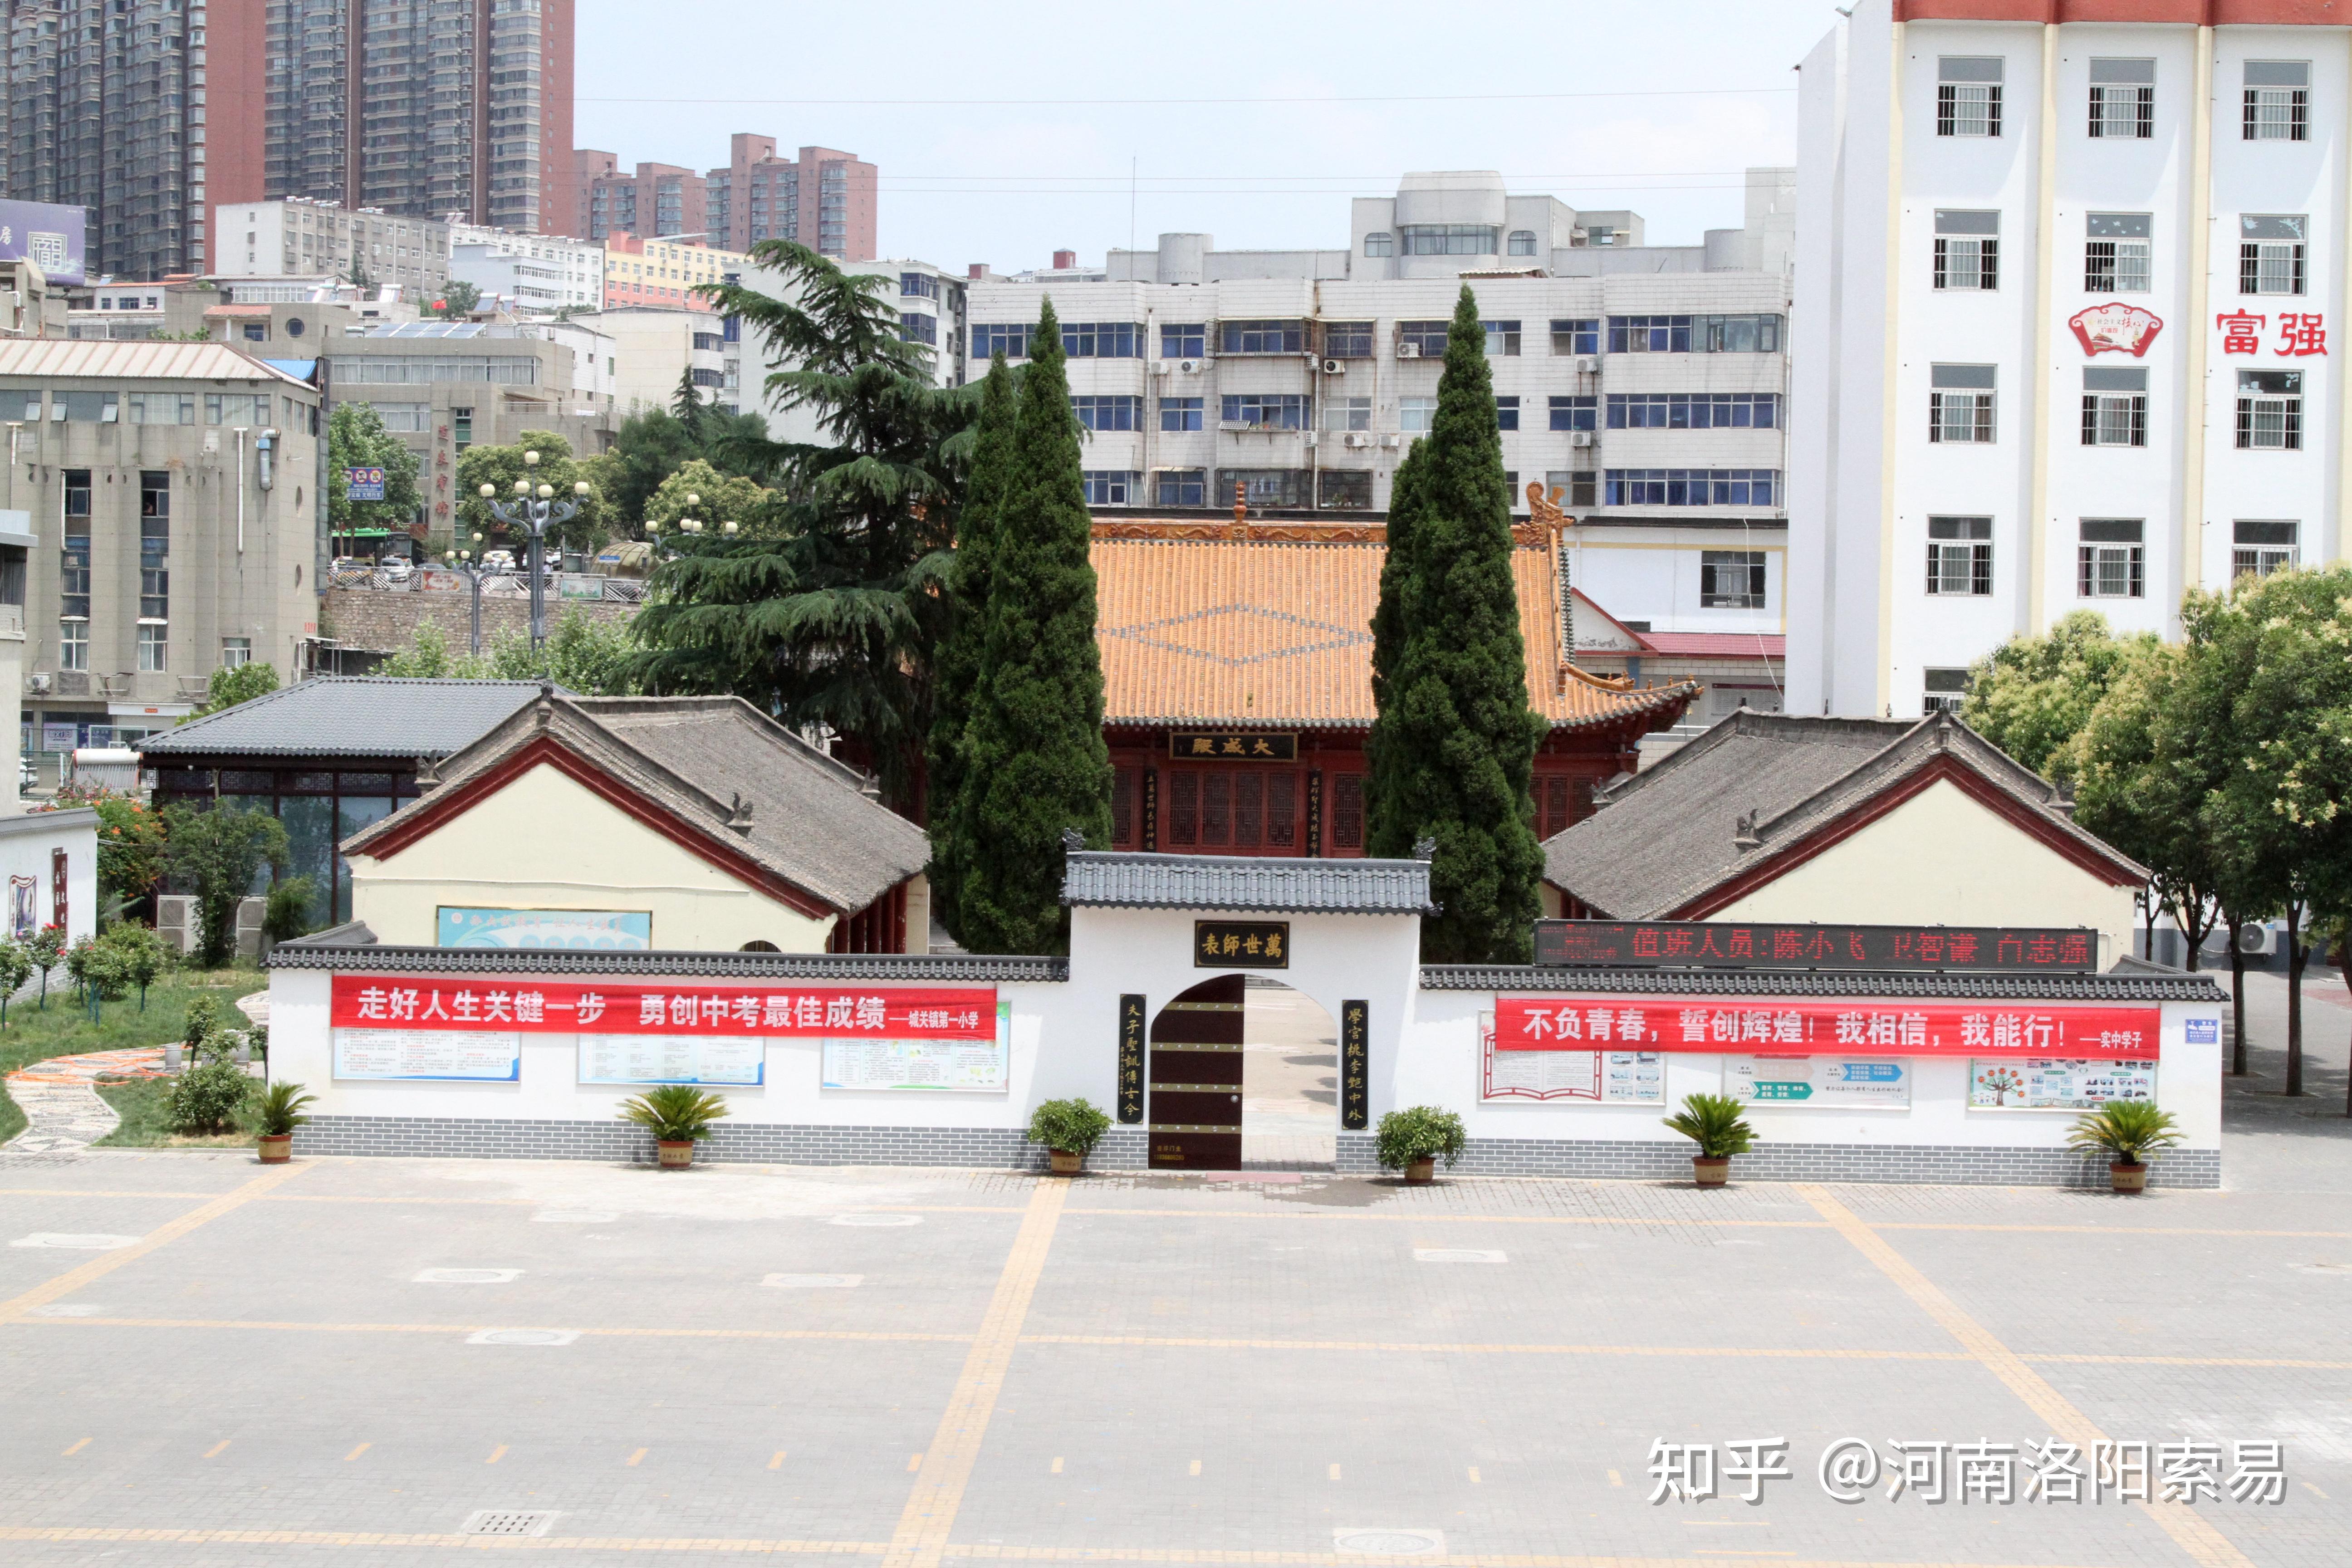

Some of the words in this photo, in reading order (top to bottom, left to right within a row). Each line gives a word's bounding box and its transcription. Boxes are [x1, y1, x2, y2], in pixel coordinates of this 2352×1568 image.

[2217, 309, 2328, 356] 富强
[358, 986, 606, 1024] 走好人生关键一步
[639, 994, 886, 1030] 勇创中考最佳成绩
